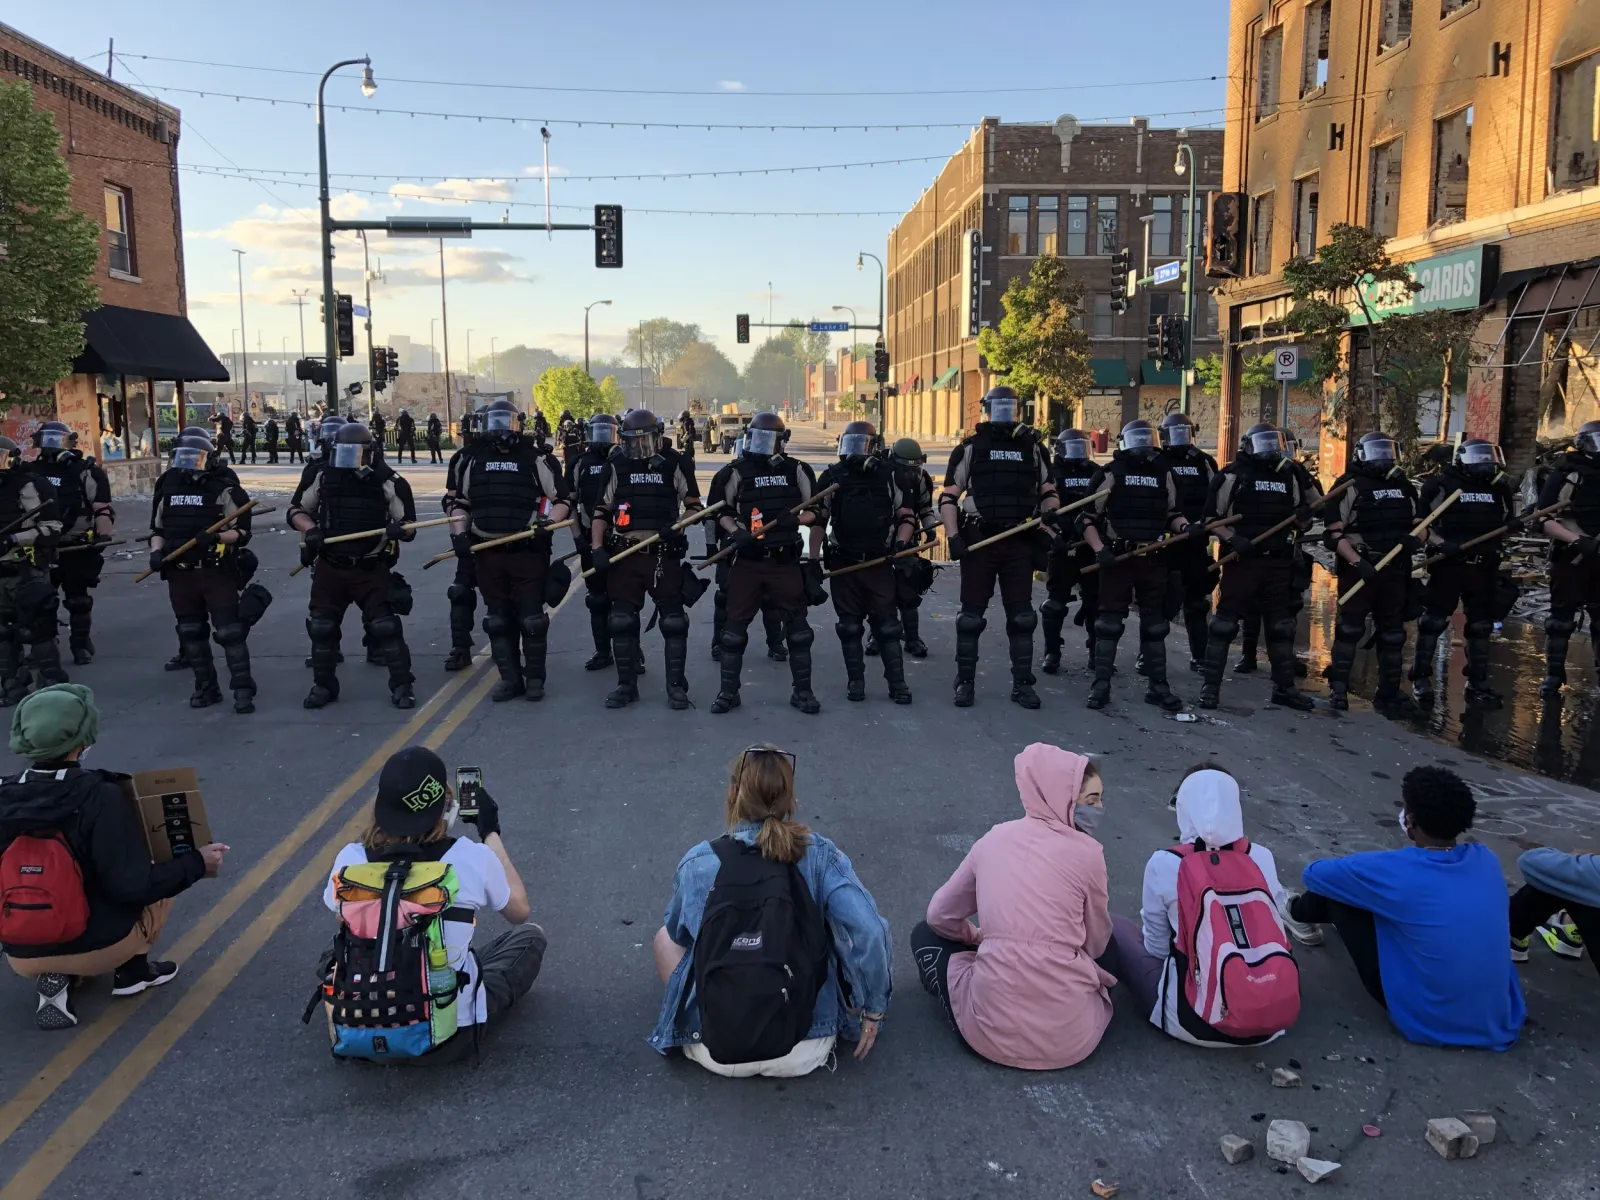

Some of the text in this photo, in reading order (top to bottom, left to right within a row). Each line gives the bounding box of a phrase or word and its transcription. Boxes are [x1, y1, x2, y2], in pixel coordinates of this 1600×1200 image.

[970, 233, 979, 334] COLISEUM
[1420, 259, 1476, 304] CARDS
[990, 450, 1022, 461] STATE PATROL
[485, 462, 518, 472] STATE PATROL
[590, 466, 603, 475] STAT
[1182, 466, 1199, 476] PATROL
[630, 473, 664, 484] STATE PATROL
[755, 475, 788, 488] STATE PATROL
[1065, 478, 1090, 487] STATE PATR
[1125, 475, 1158, 488] STATE PATROL
[1255, 480, 1287, 494] STATE PATROL
[1387, 489, 1404, 498] PATROL
[1460, 493, 1495, 503] STATE PATROL
[170, 495, 203, 506] STATE PATROL
